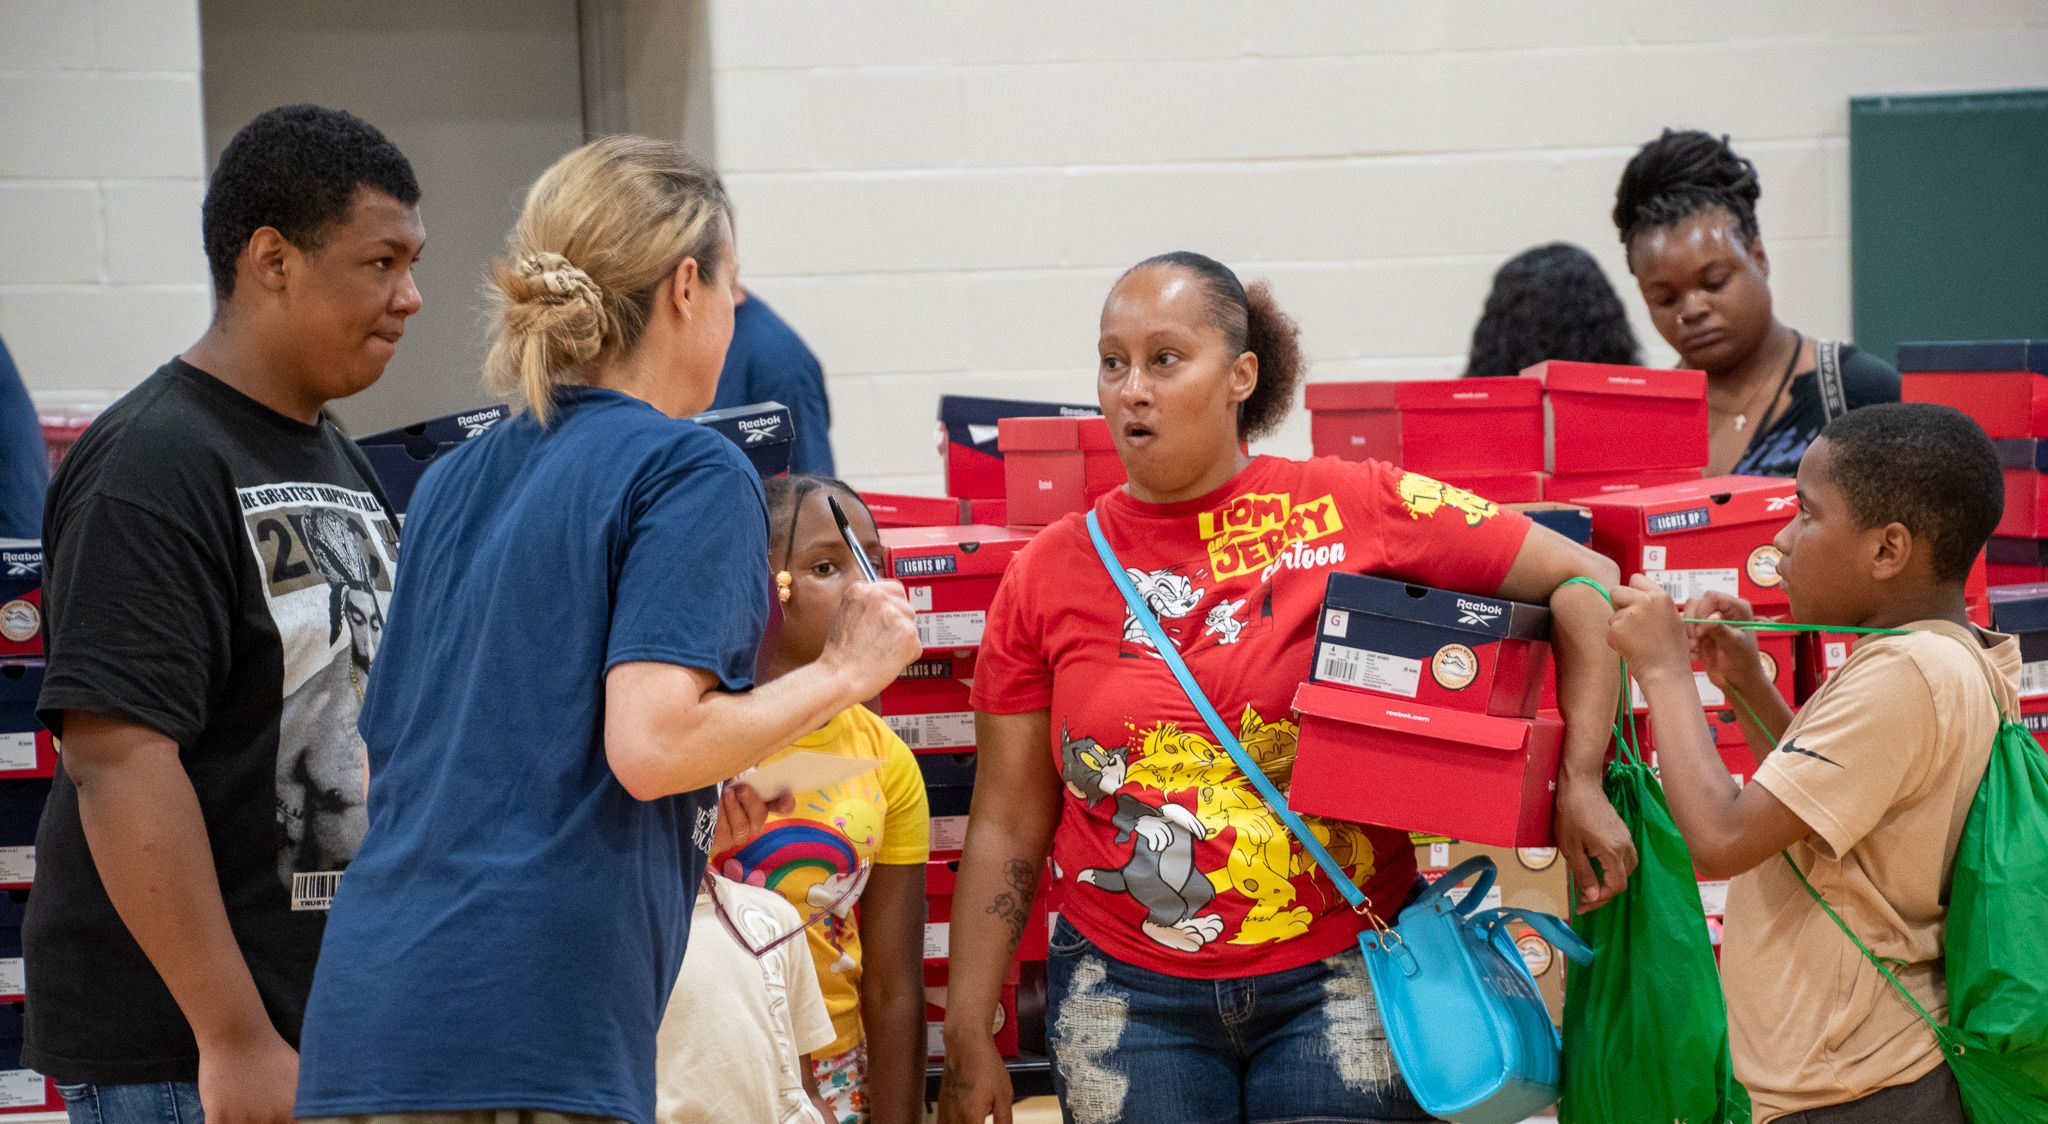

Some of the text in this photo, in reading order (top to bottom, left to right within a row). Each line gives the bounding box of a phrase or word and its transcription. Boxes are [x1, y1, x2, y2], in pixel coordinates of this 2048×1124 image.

[457, 409, 501, 427] Reebok
[738, 415, 781, 431] Reebok
[255, 486, 320, 506] GREATEST
[316, 486, 355, 508] RAPPER
[1203, 496, 1286, 535] TOM
[1657, 512, 1700, 529] LIGHTS UP
[1207, 532, 1230, 554] and
[1215, 502, 1330, 573] JERRY
[1648, 551, 1658, 561] G
[904, 558, 946, 573] LIGHTS UP
[914, 587, 924, 597] G
[1456, 598, 1503, 615] Reebok
[1330, 614, 1342, 627] G
[1830, 647, 1840, 657] G
[903, 663, 943, 676] IGHTS UP
[1385, 710, 1430, 722] reebok.com
[1434, 843, 1443, 853] G
